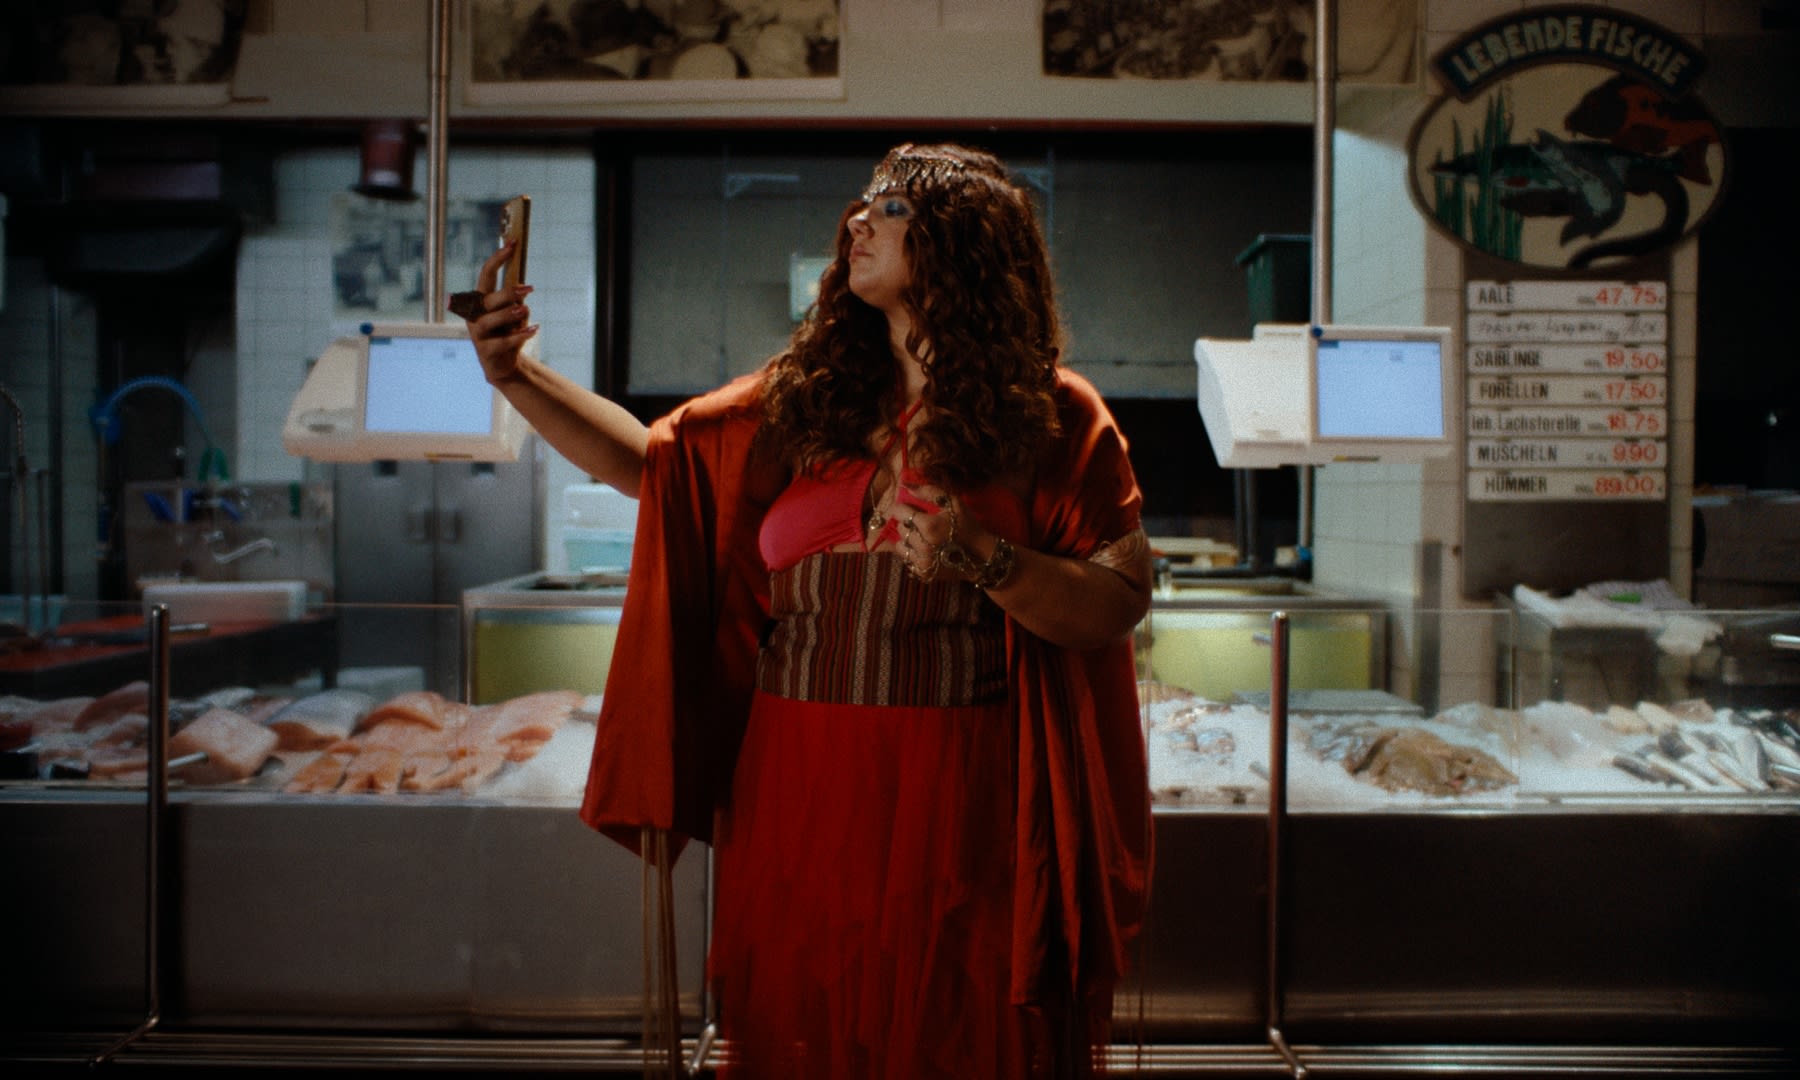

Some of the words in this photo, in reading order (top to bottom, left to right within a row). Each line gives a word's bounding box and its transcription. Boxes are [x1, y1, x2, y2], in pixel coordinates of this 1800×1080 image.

[1452, 16, 1583, 83] LEBENDE
[1590, 18, 1690, 85] FISCHE
[1478, 287, 1514, 304] AALE
[1480, 383, 1549, 399] FORELLEN
[1478, 446, 1557, 462] MUSCHELN
[1486, 476, 1547, 493] HUMMER
